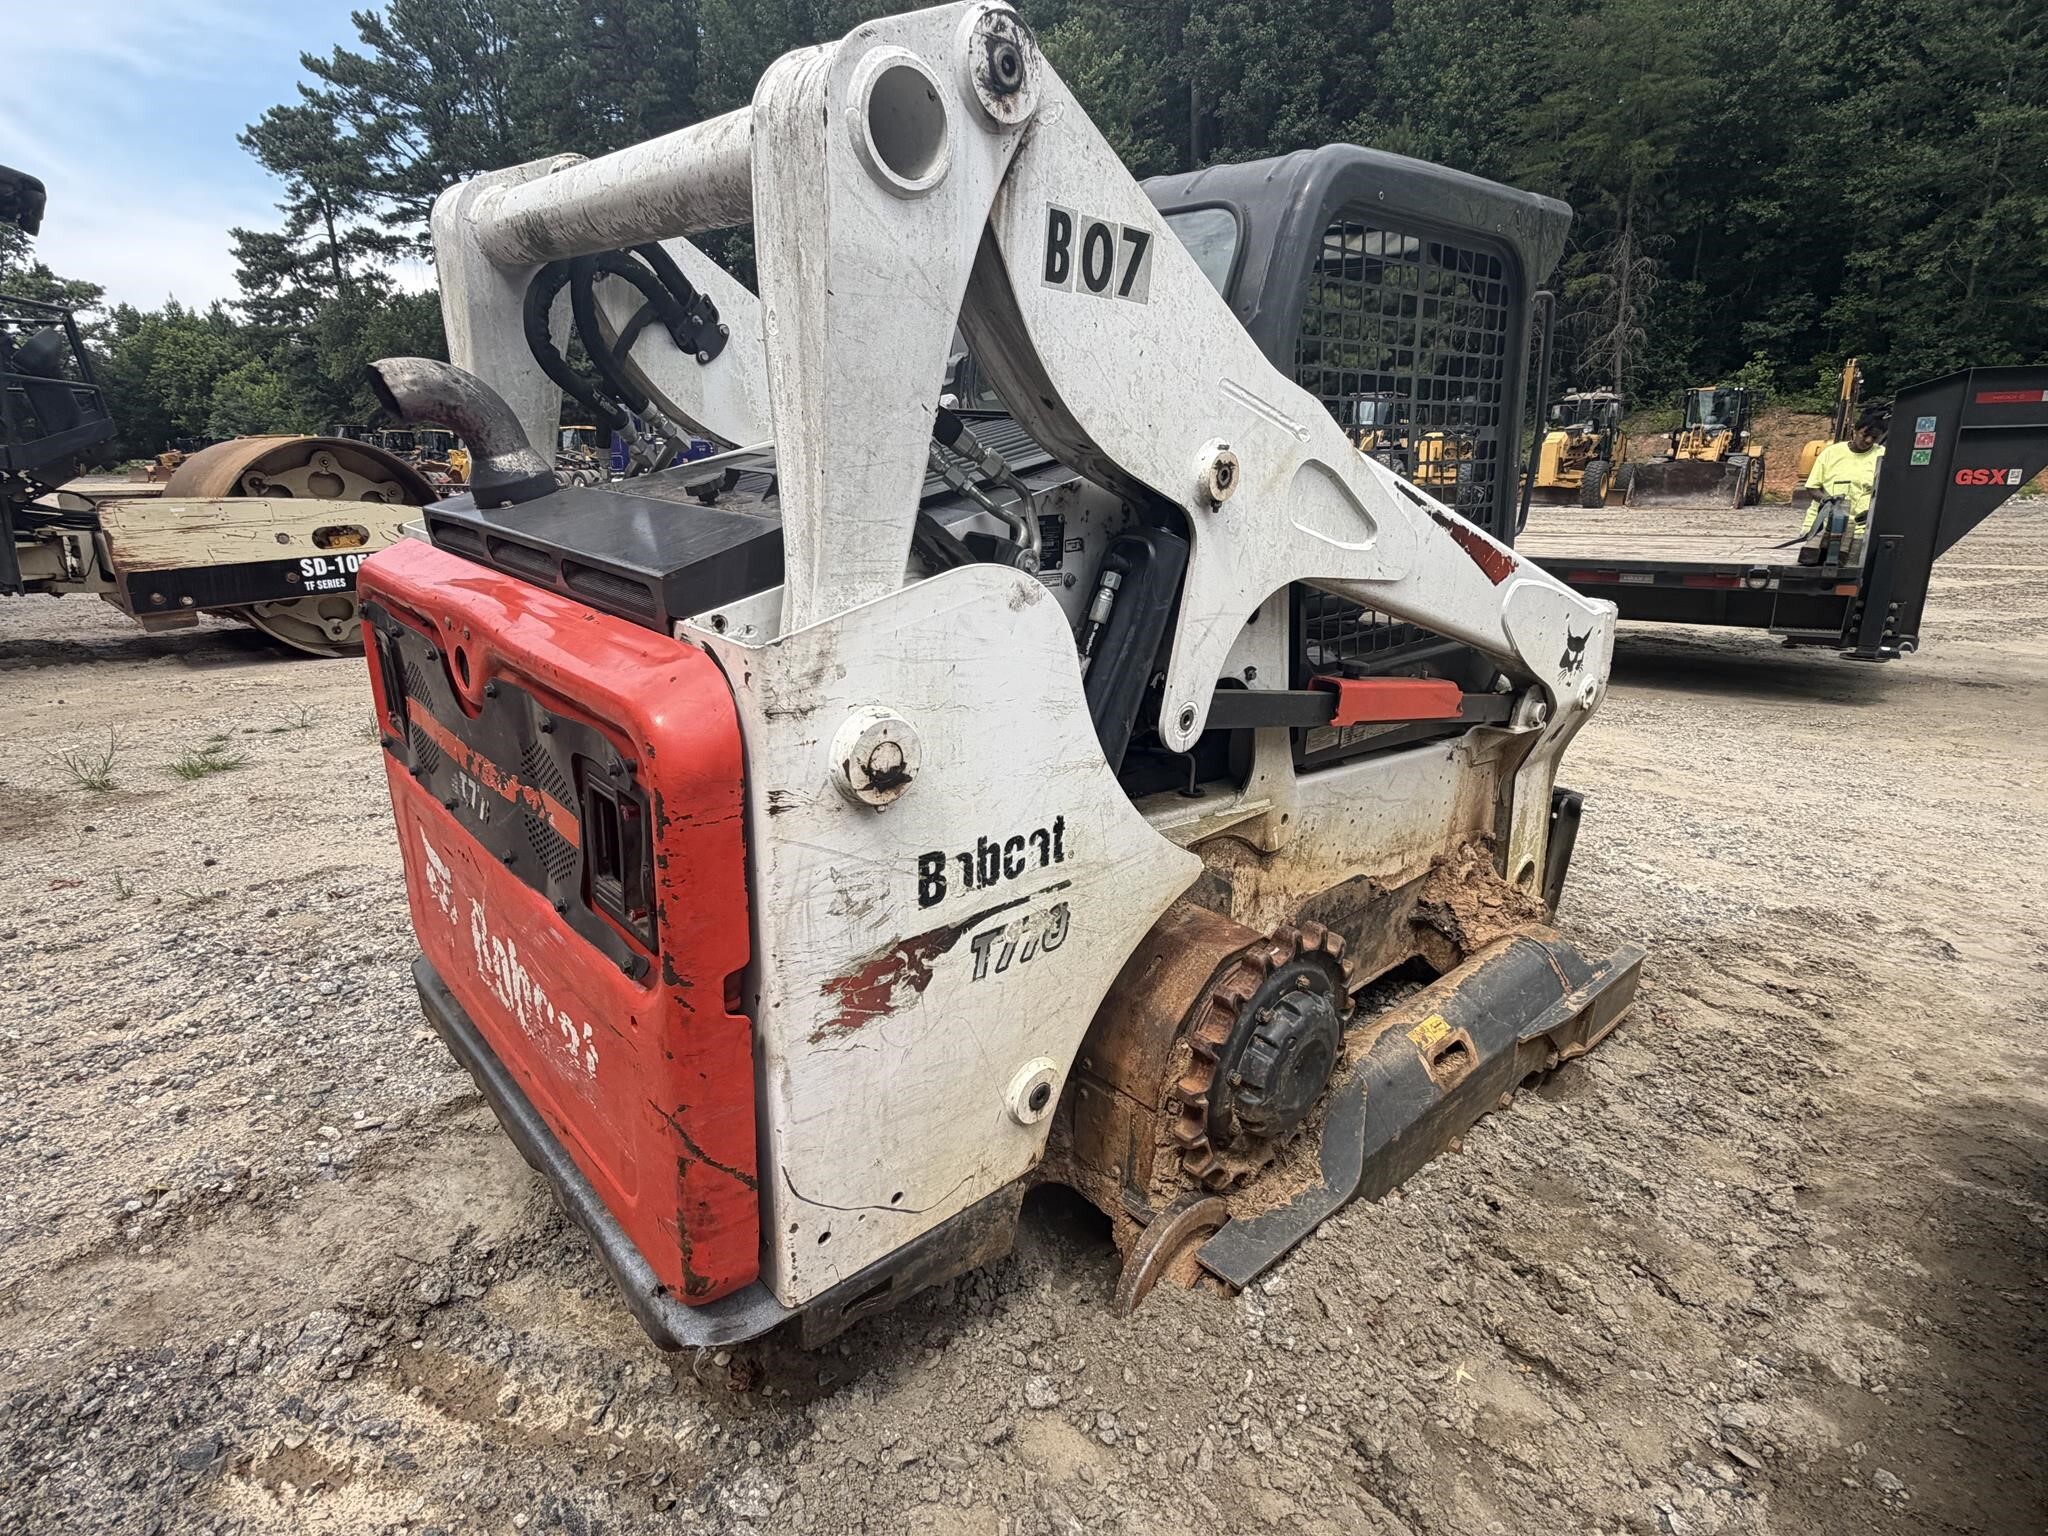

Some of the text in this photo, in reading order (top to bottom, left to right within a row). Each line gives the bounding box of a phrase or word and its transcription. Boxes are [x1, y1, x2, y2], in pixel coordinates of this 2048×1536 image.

[1955, 468, 2007, 486] GSX
[304, 577, 347, 592] TF SERIES
